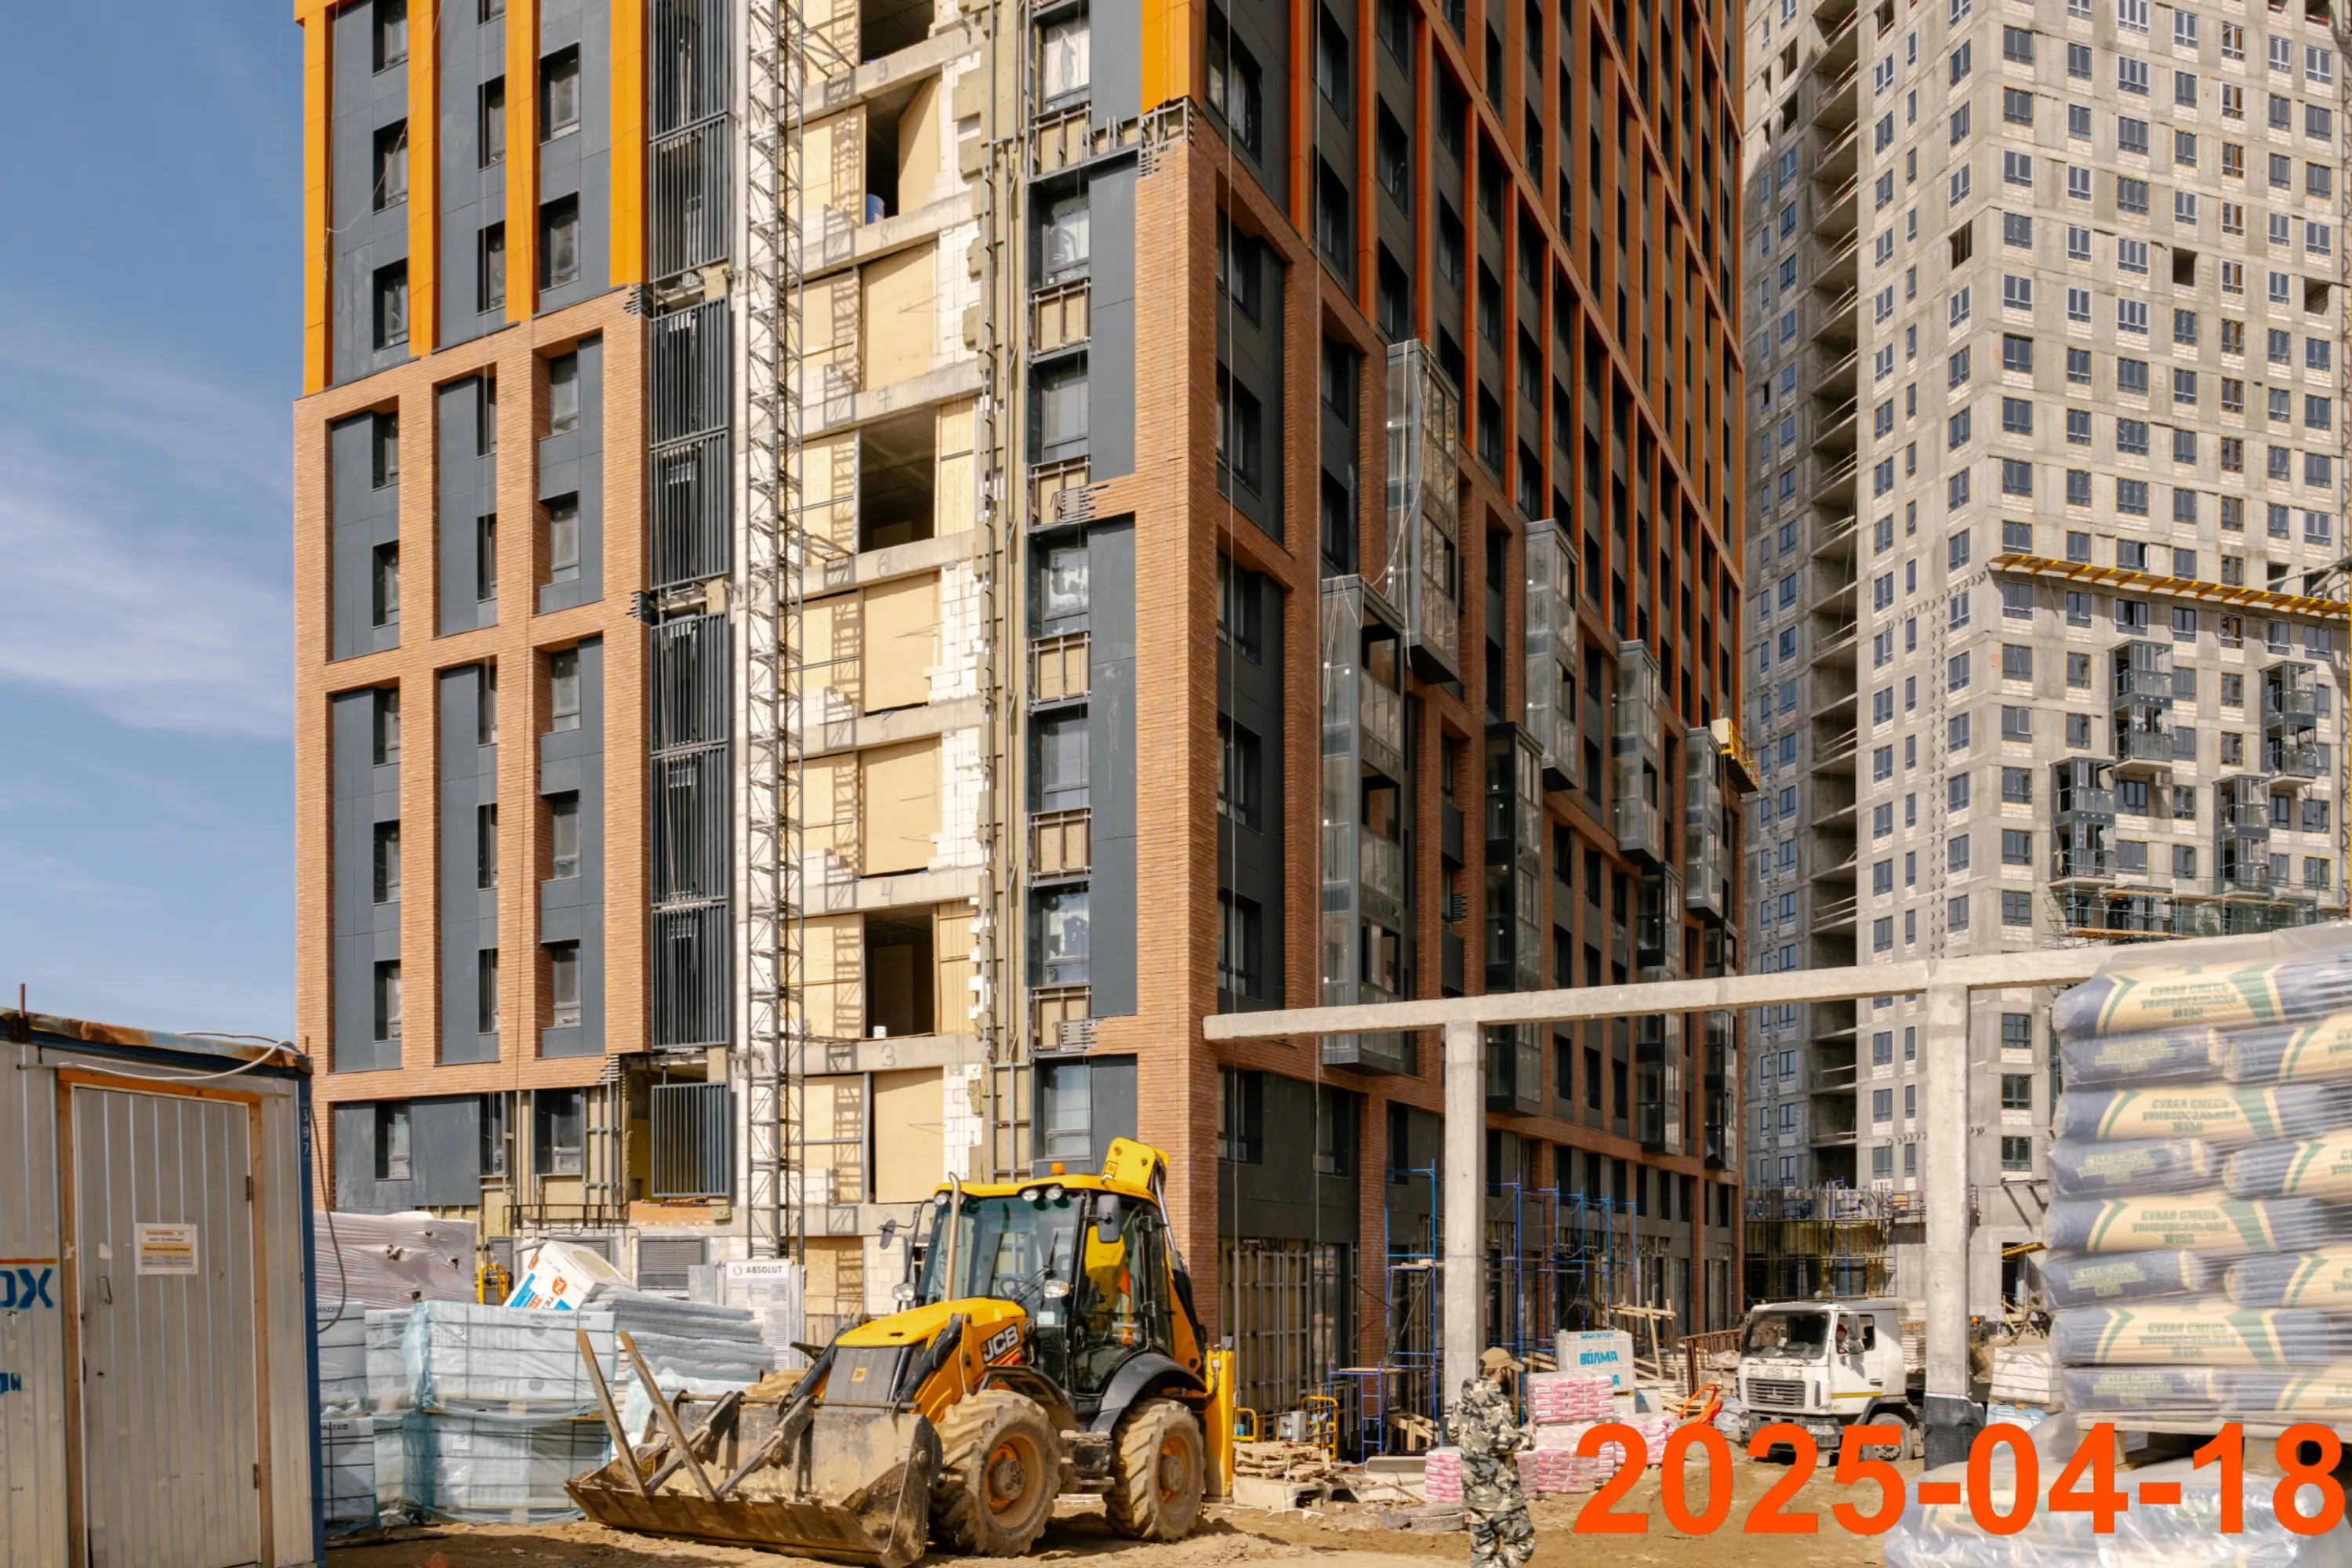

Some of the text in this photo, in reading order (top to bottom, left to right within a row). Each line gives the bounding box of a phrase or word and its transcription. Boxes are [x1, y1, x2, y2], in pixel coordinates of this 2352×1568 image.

[877, 60, 888, 82] 9
[880, 223, 891, 249] 8
[877, 387, 892, 412] 7
[877, 553, 889, 578] 6
[881, 880, 894, 906] 4
[881, 1044, 896, 1068] 3
[746, 1265, 783, 1274] ABSOLUT
[982, 1324, 1020, 1363] JCB
